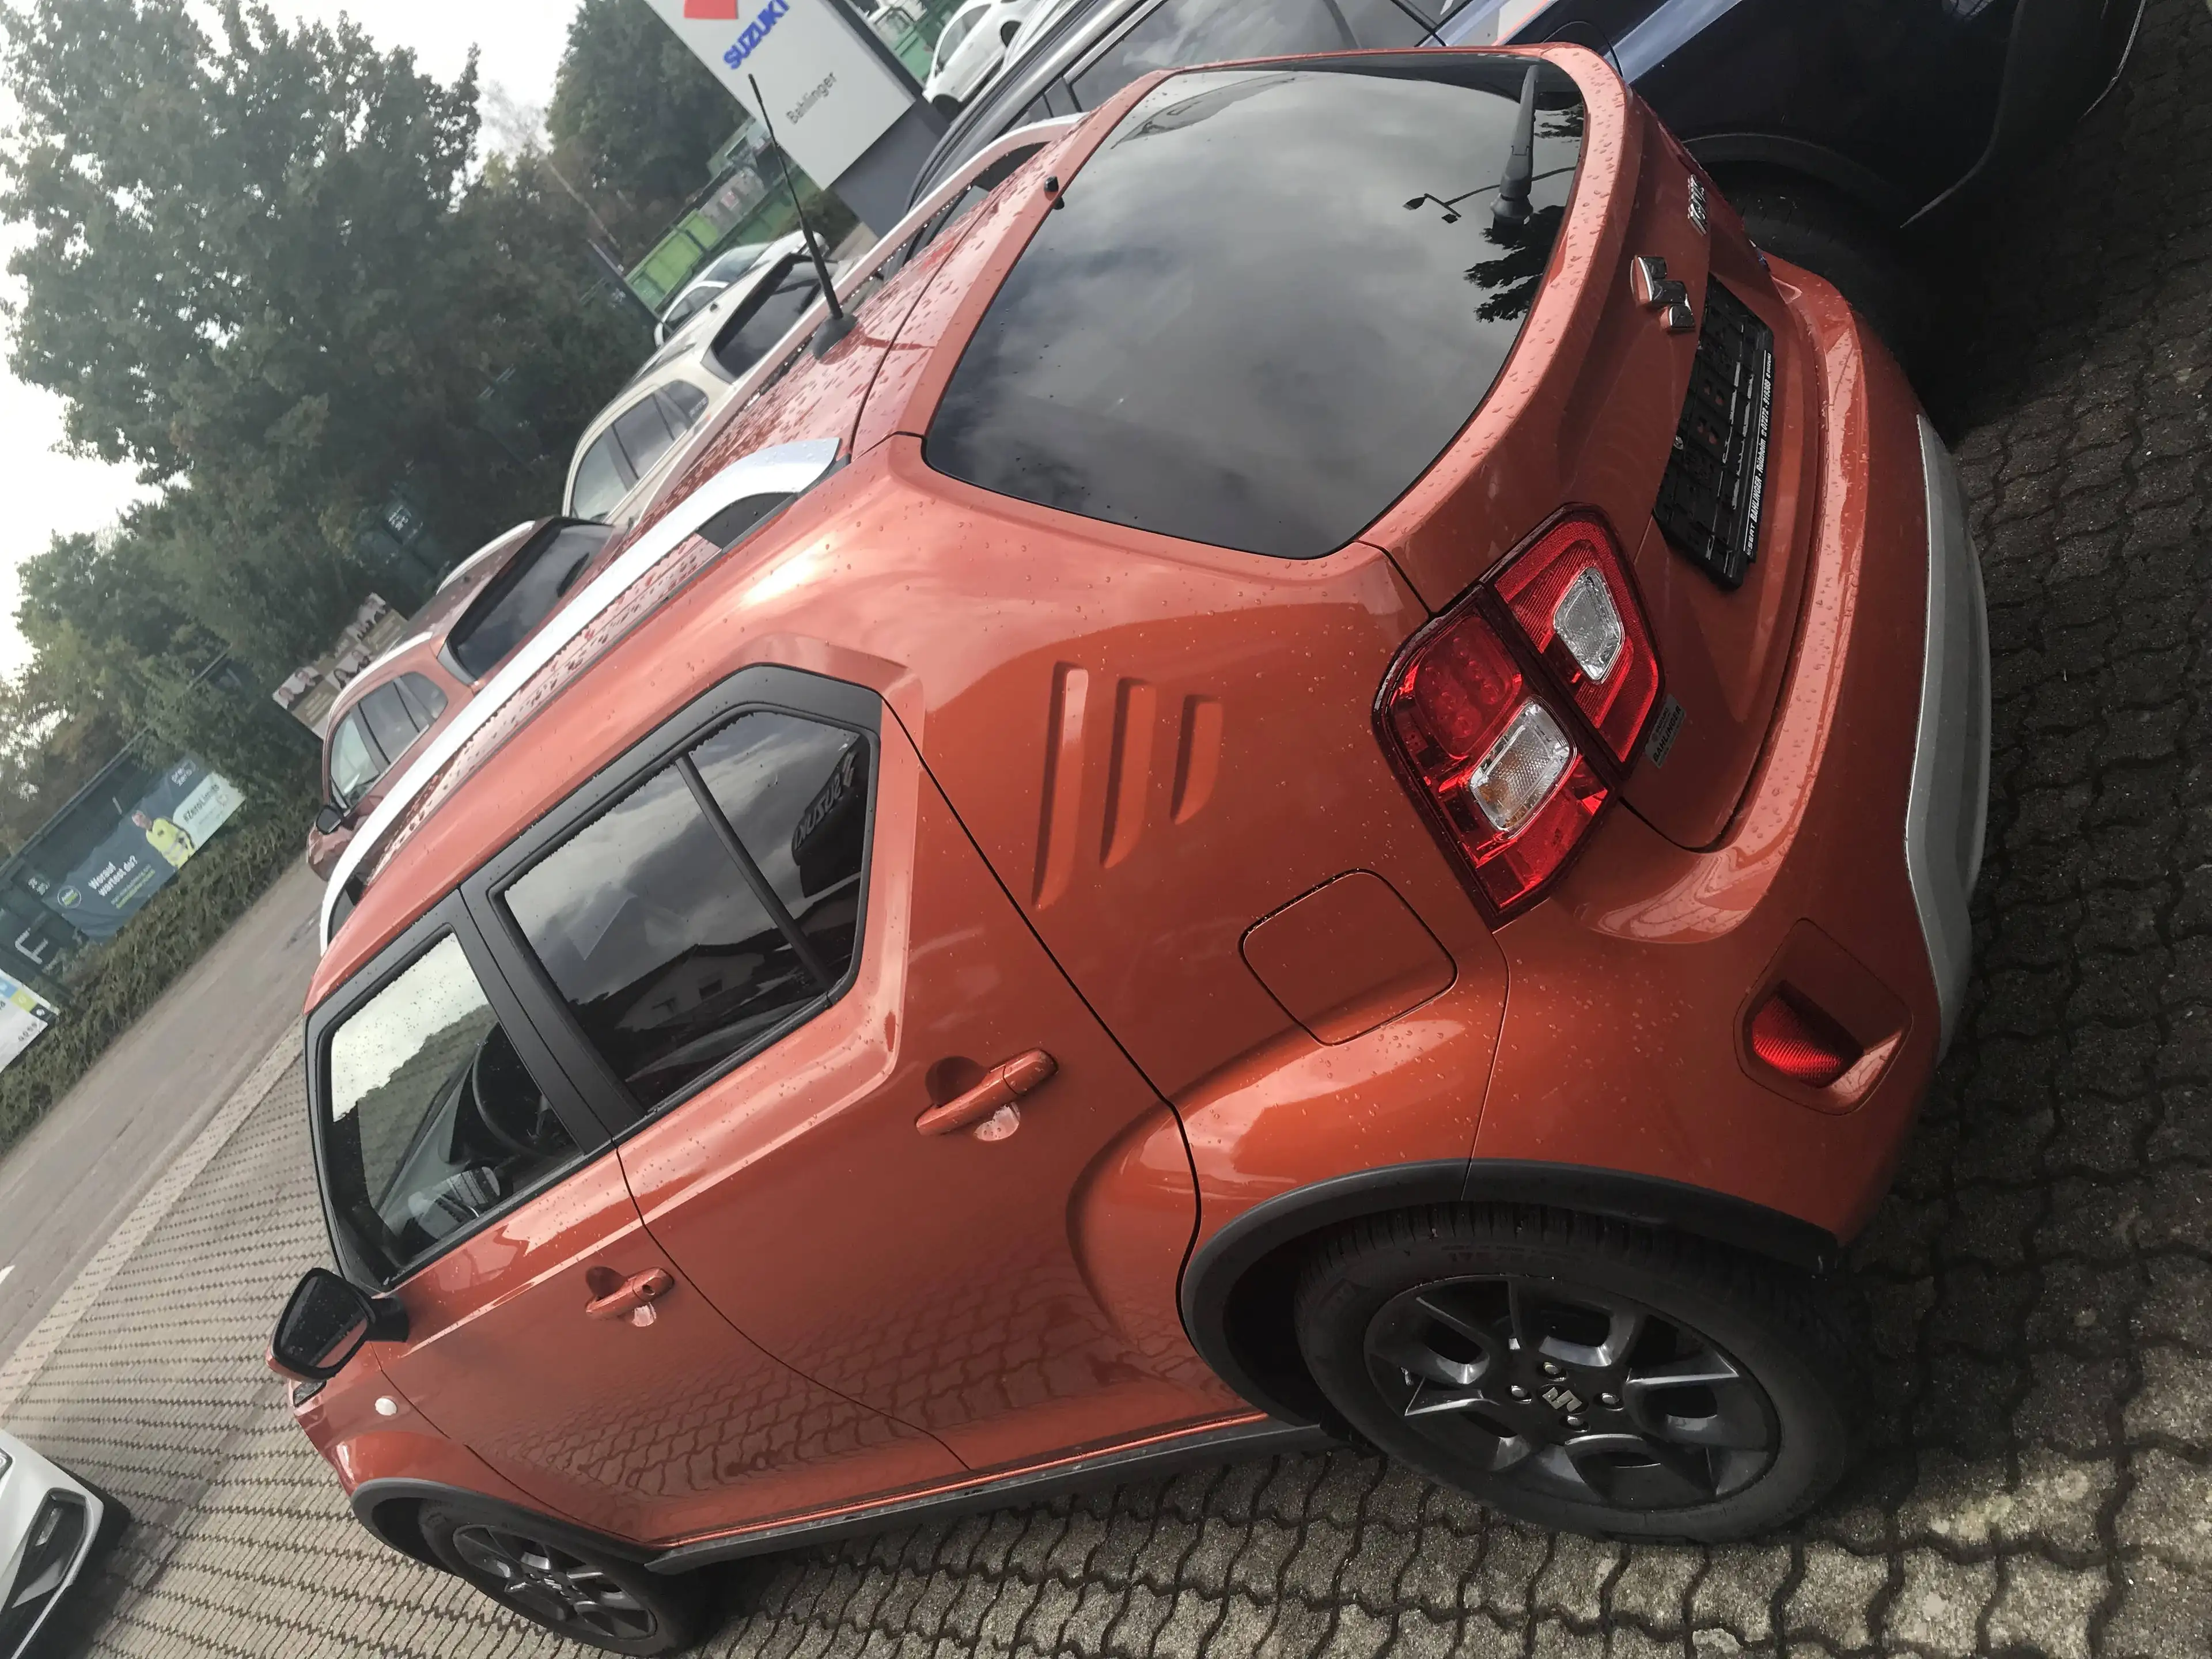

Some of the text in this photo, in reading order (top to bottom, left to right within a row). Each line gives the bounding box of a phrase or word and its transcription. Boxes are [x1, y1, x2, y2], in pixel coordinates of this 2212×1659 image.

[724, 0, 790, 70] SUZUKI
[1750, 475, 1762, 522] BAHLINGER
[1756, 438, 1766, 473] Rülzheim
[1761, 407, 1769, 430] 07272
[1653, 705, 1681, 762] BAHLINGER
